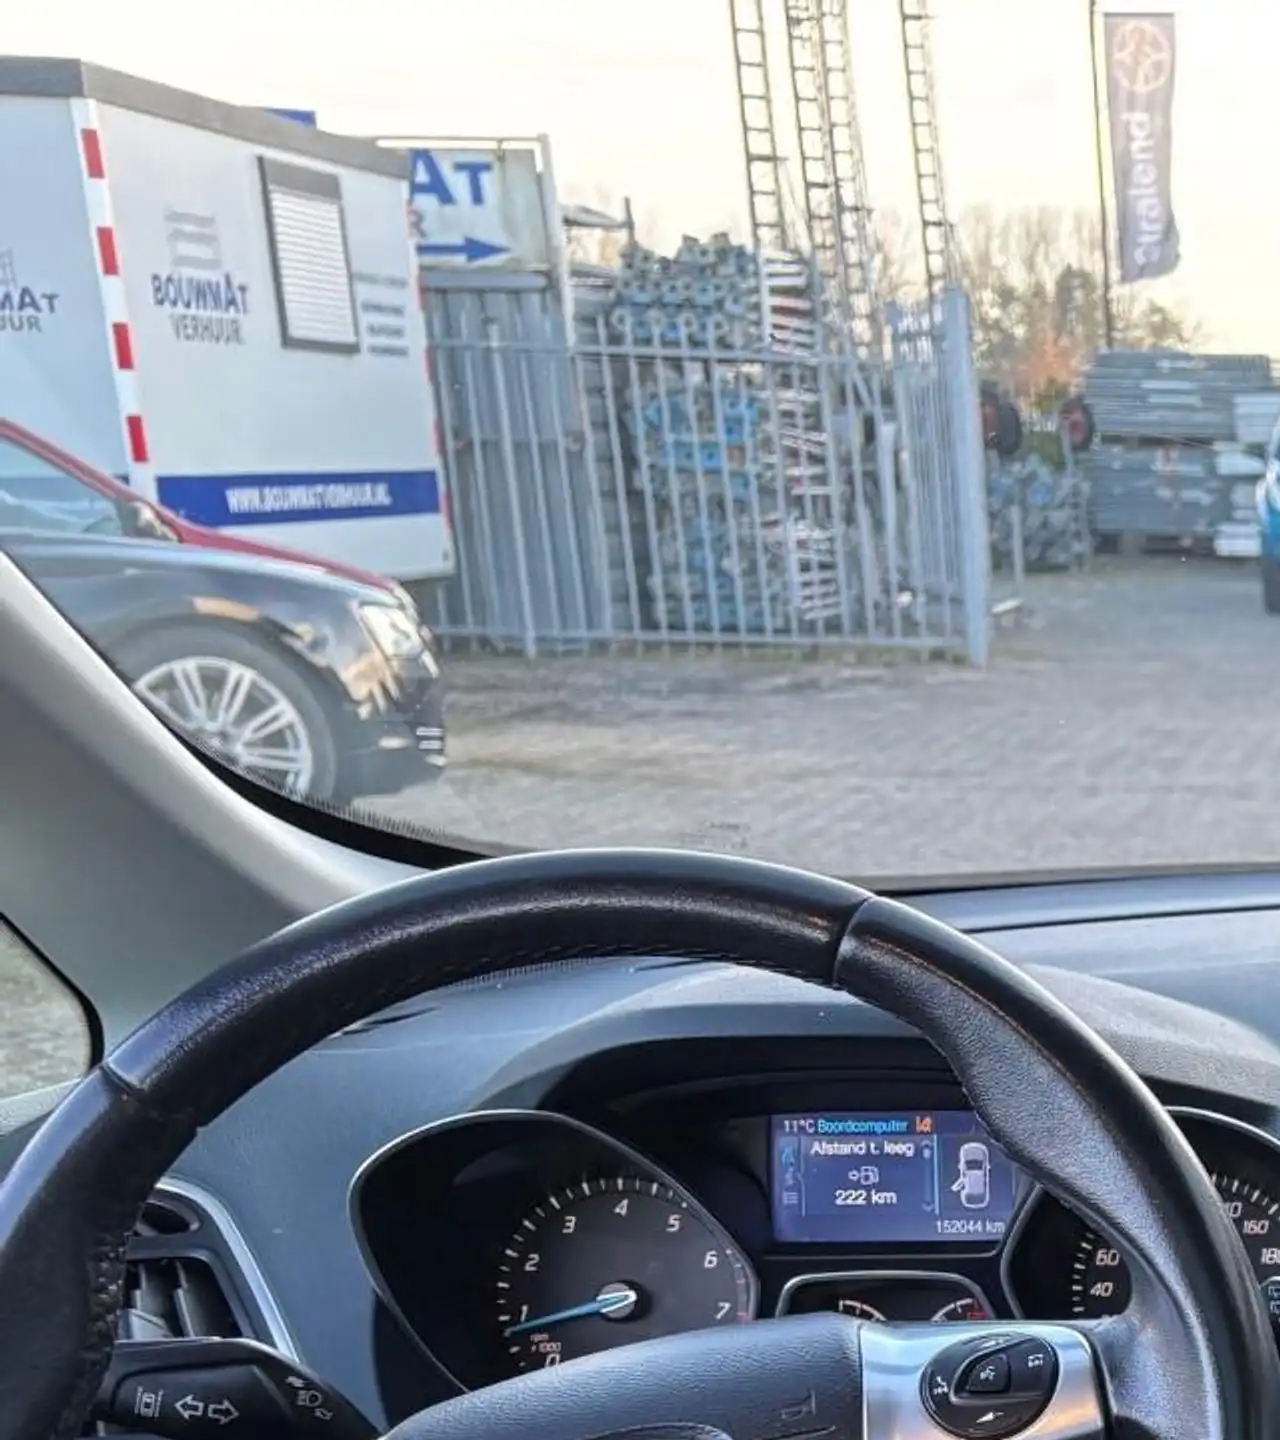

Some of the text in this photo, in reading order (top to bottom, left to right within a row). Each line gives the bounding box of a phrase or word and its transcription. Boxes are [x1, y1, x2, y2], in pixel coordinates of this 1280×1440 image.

[152, 272, 248, 314] BOUWMAT
[170, 313, 246, 345] VERHUUR
[783, 1119, 908, 1135] 11°C Boordcomputer
[810, 1141, 866, 1156] Afstand
[835, 1189, 897, 1205] 222 km
[613, 1199, 629, 1217] 4
[562, 1216, 576, 1233] 3
[666, 1214, 680, 1232] 5
[935, 1219, 1005, 1234] 152044 km
[524, 1253, 540, 1272] 2
[704, 1251, 718, 1269] 6
[1096, 1249, 1120, 1266] 60
[1090, 1282, 1113, 1298] 40
[715, 1302, 731, 1319] 7
